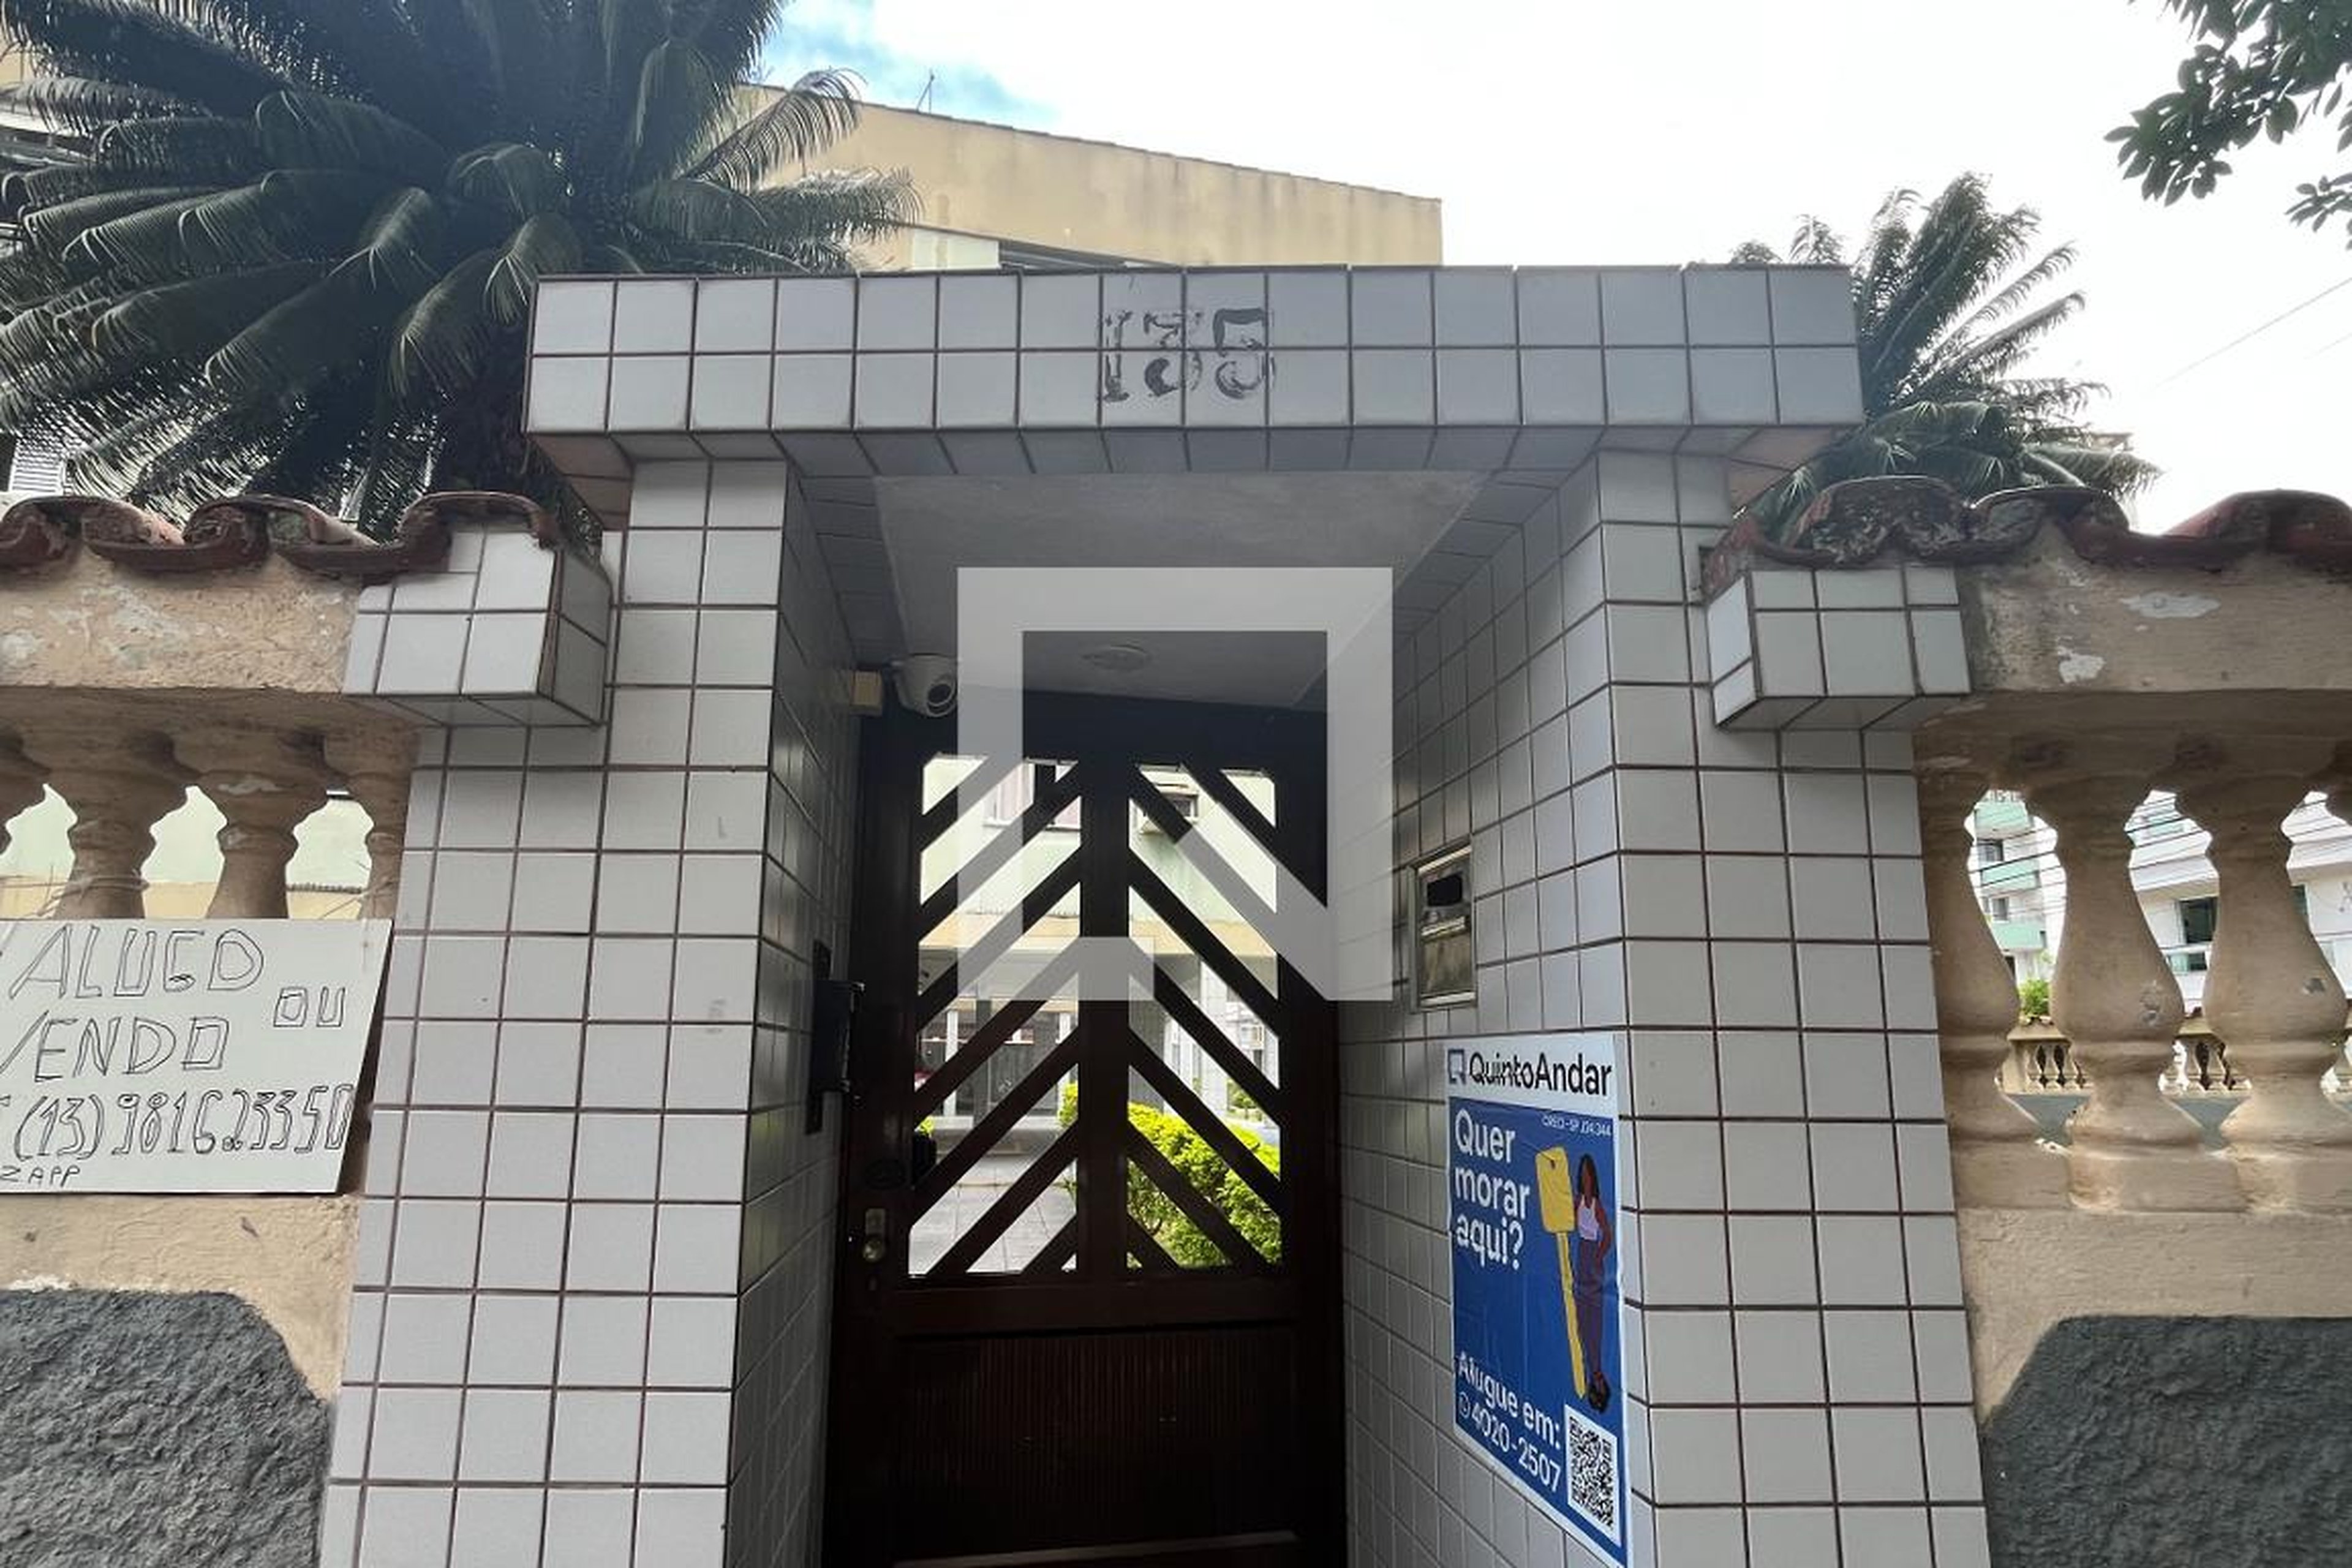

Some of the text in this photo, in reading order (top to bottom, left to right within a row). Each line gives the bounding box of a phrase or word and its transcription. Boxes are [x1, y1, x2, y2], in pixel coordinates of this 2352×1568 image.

[1101, 306, 1276, 402] 135
[273, 986, 345, 1027] OU
[1469, 1052, 1612, 1096] QuintoAndar
[1455, 1109, 1516, 1163] Quer
[1455, 1166, 1530, 1220] morar
[1455, 1213, 1524, 1270] aqui?
[1458, 1350, 1561, 1450] Alugue em:
[1471, 1401, 1562, 1493] 4020-2507
